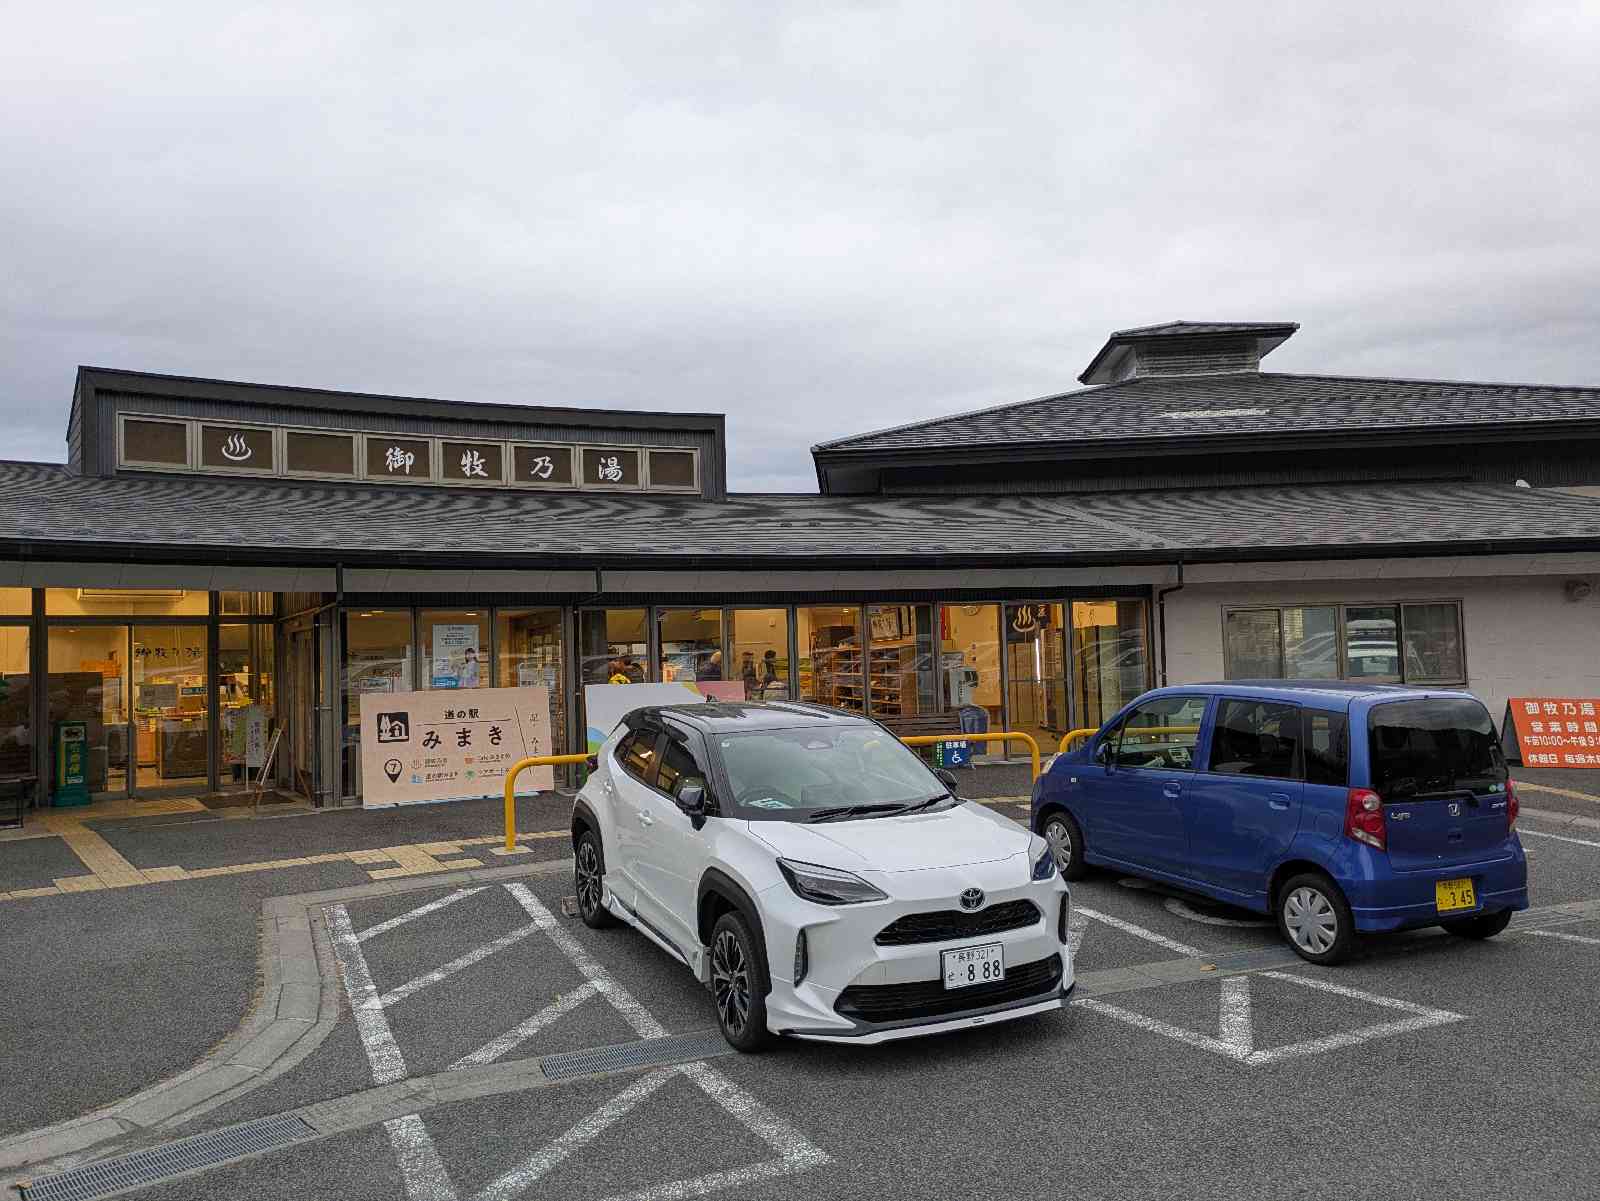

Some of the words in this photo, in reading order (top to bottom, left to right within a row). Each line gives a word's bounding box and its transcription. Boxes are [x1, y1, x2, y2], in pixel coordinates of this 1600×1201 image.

[385, 447, 624, 482] 御牧乃湯
[444, 708, 479, 720] 道の駅
[422, 726, 502, 749] みまき
